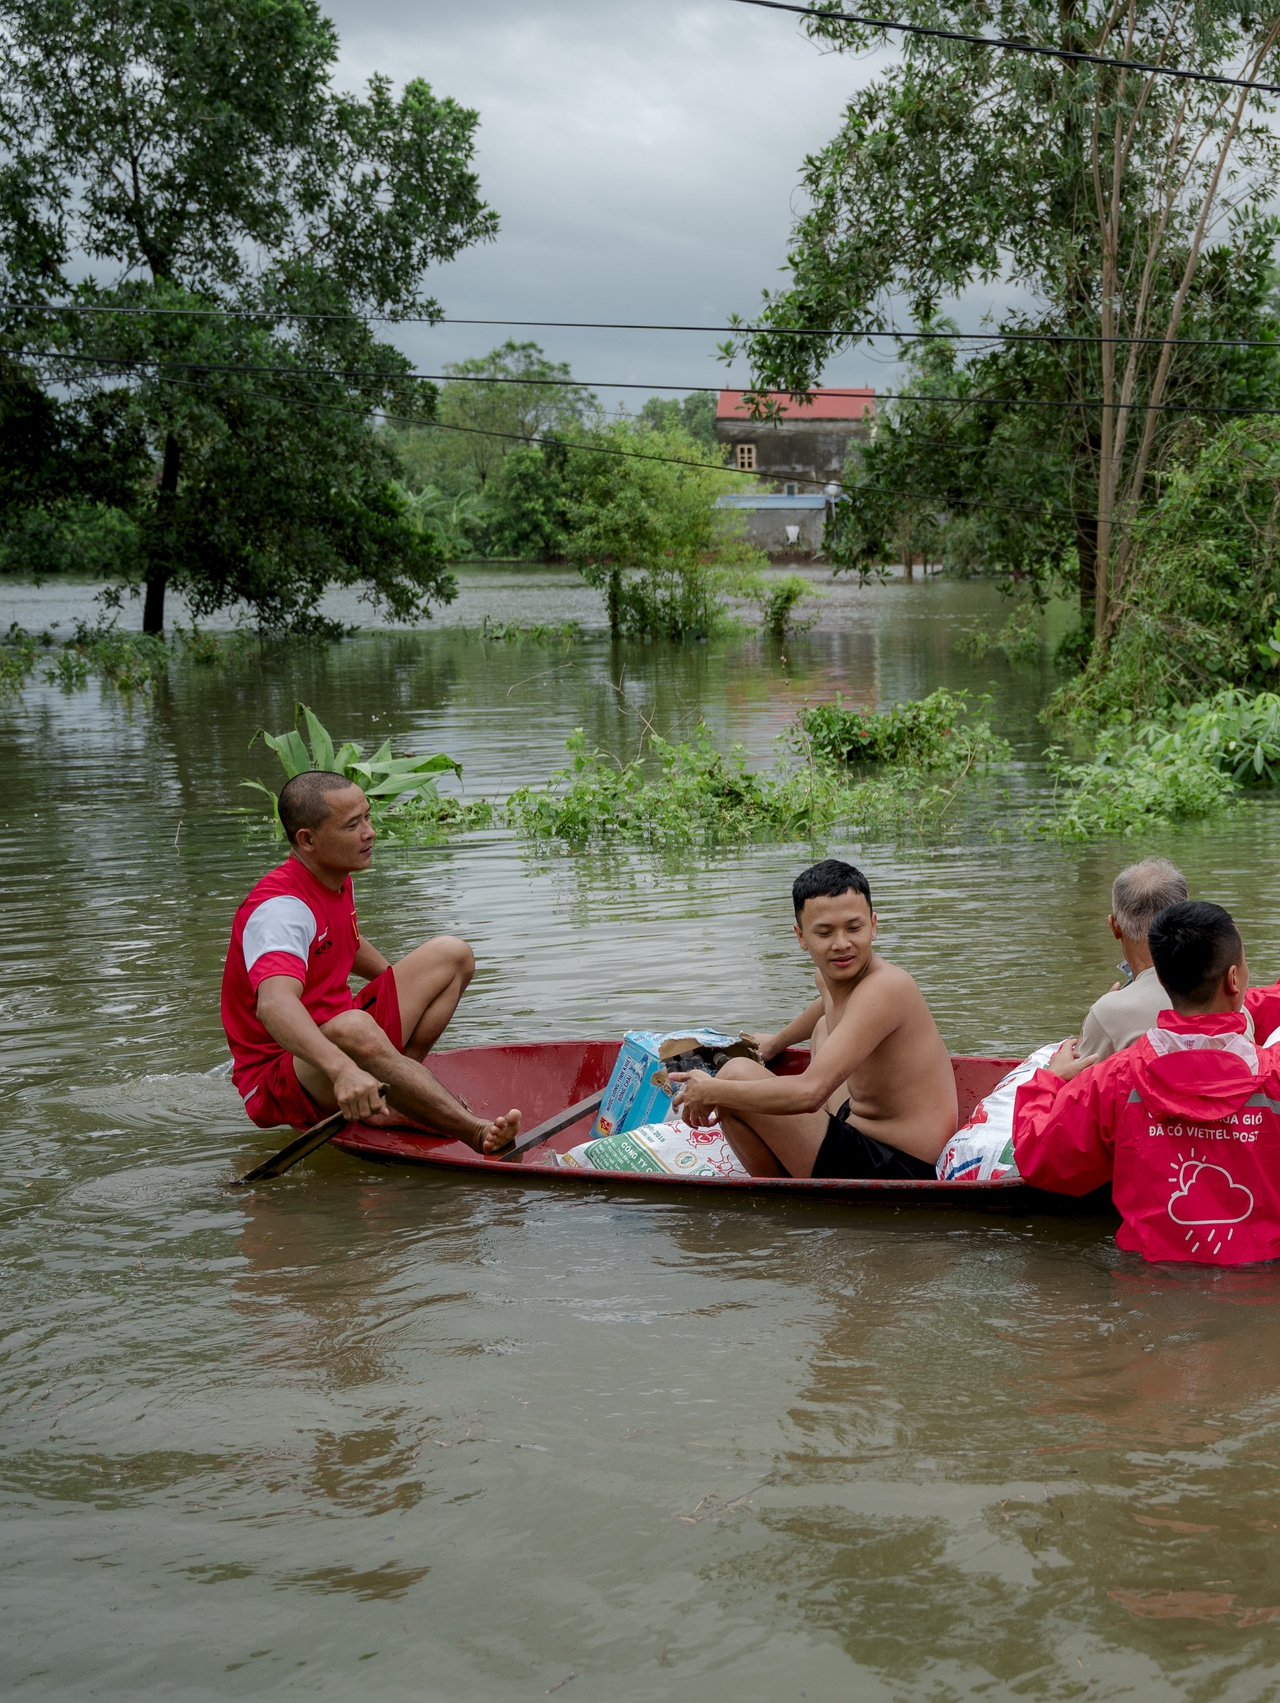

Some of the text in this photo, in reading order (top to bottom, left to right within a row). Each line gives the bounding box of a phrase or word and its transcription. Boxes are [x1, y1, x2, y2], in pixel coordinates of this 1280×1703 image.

[1242, 1112, 1263, 1125] GIÓ
[1149, 1123, 1260, 1142] ĐÃ CÓ VIETTEL POST
[621, 1142, 638, 1160] CÔNG
[638, 1158, 647, 1168] TY
